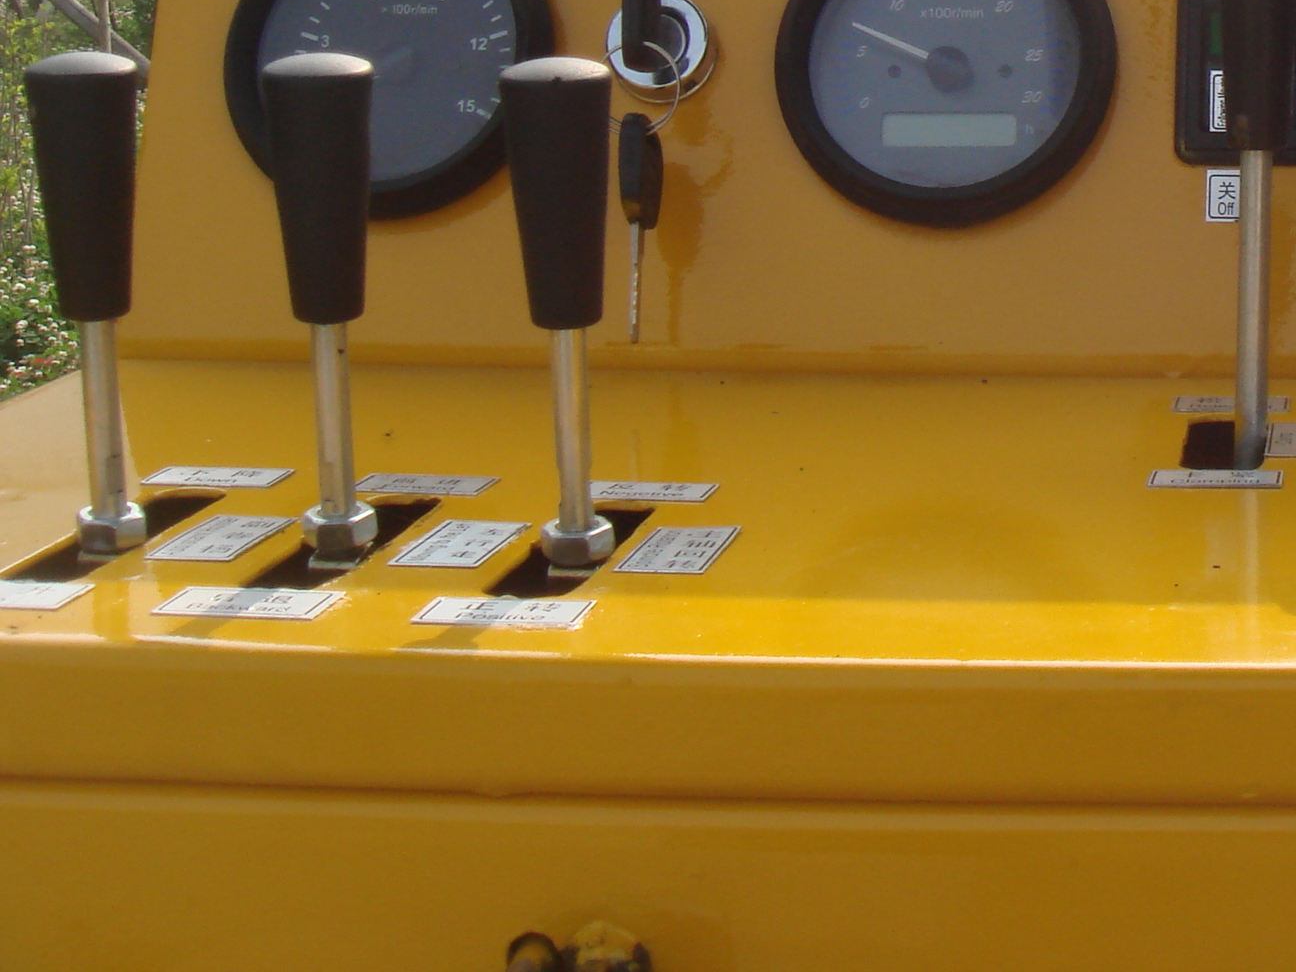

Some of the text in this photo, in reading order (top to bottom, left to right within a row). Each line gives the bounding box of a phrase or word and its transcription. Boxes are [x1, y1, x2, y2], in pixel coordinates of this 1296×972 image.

[889, 0, 905, 11] 10
[995, 0, 1013, 13] 20
[321, 34, 330, 47] 3
[469, 37, 487, 50] 12
[856, 45, 867, 57] 5
[1025, 49, 1043, 61] 25
[860, 97, 869, 109] 0
[1022, 91, 1042, 103] 30
[458, 99, 475, 113] 15
[1025, 124, 1033, 134] h
[1218, 182, 1236, 200] 关
[1217, 202, 1235, 215] Off
[608, 483, 691, 491] 反转
[187, 603, 292, 612] Backward
[460, 602, 561, 612] 正转
[455, 611, 545, 621] Positive
